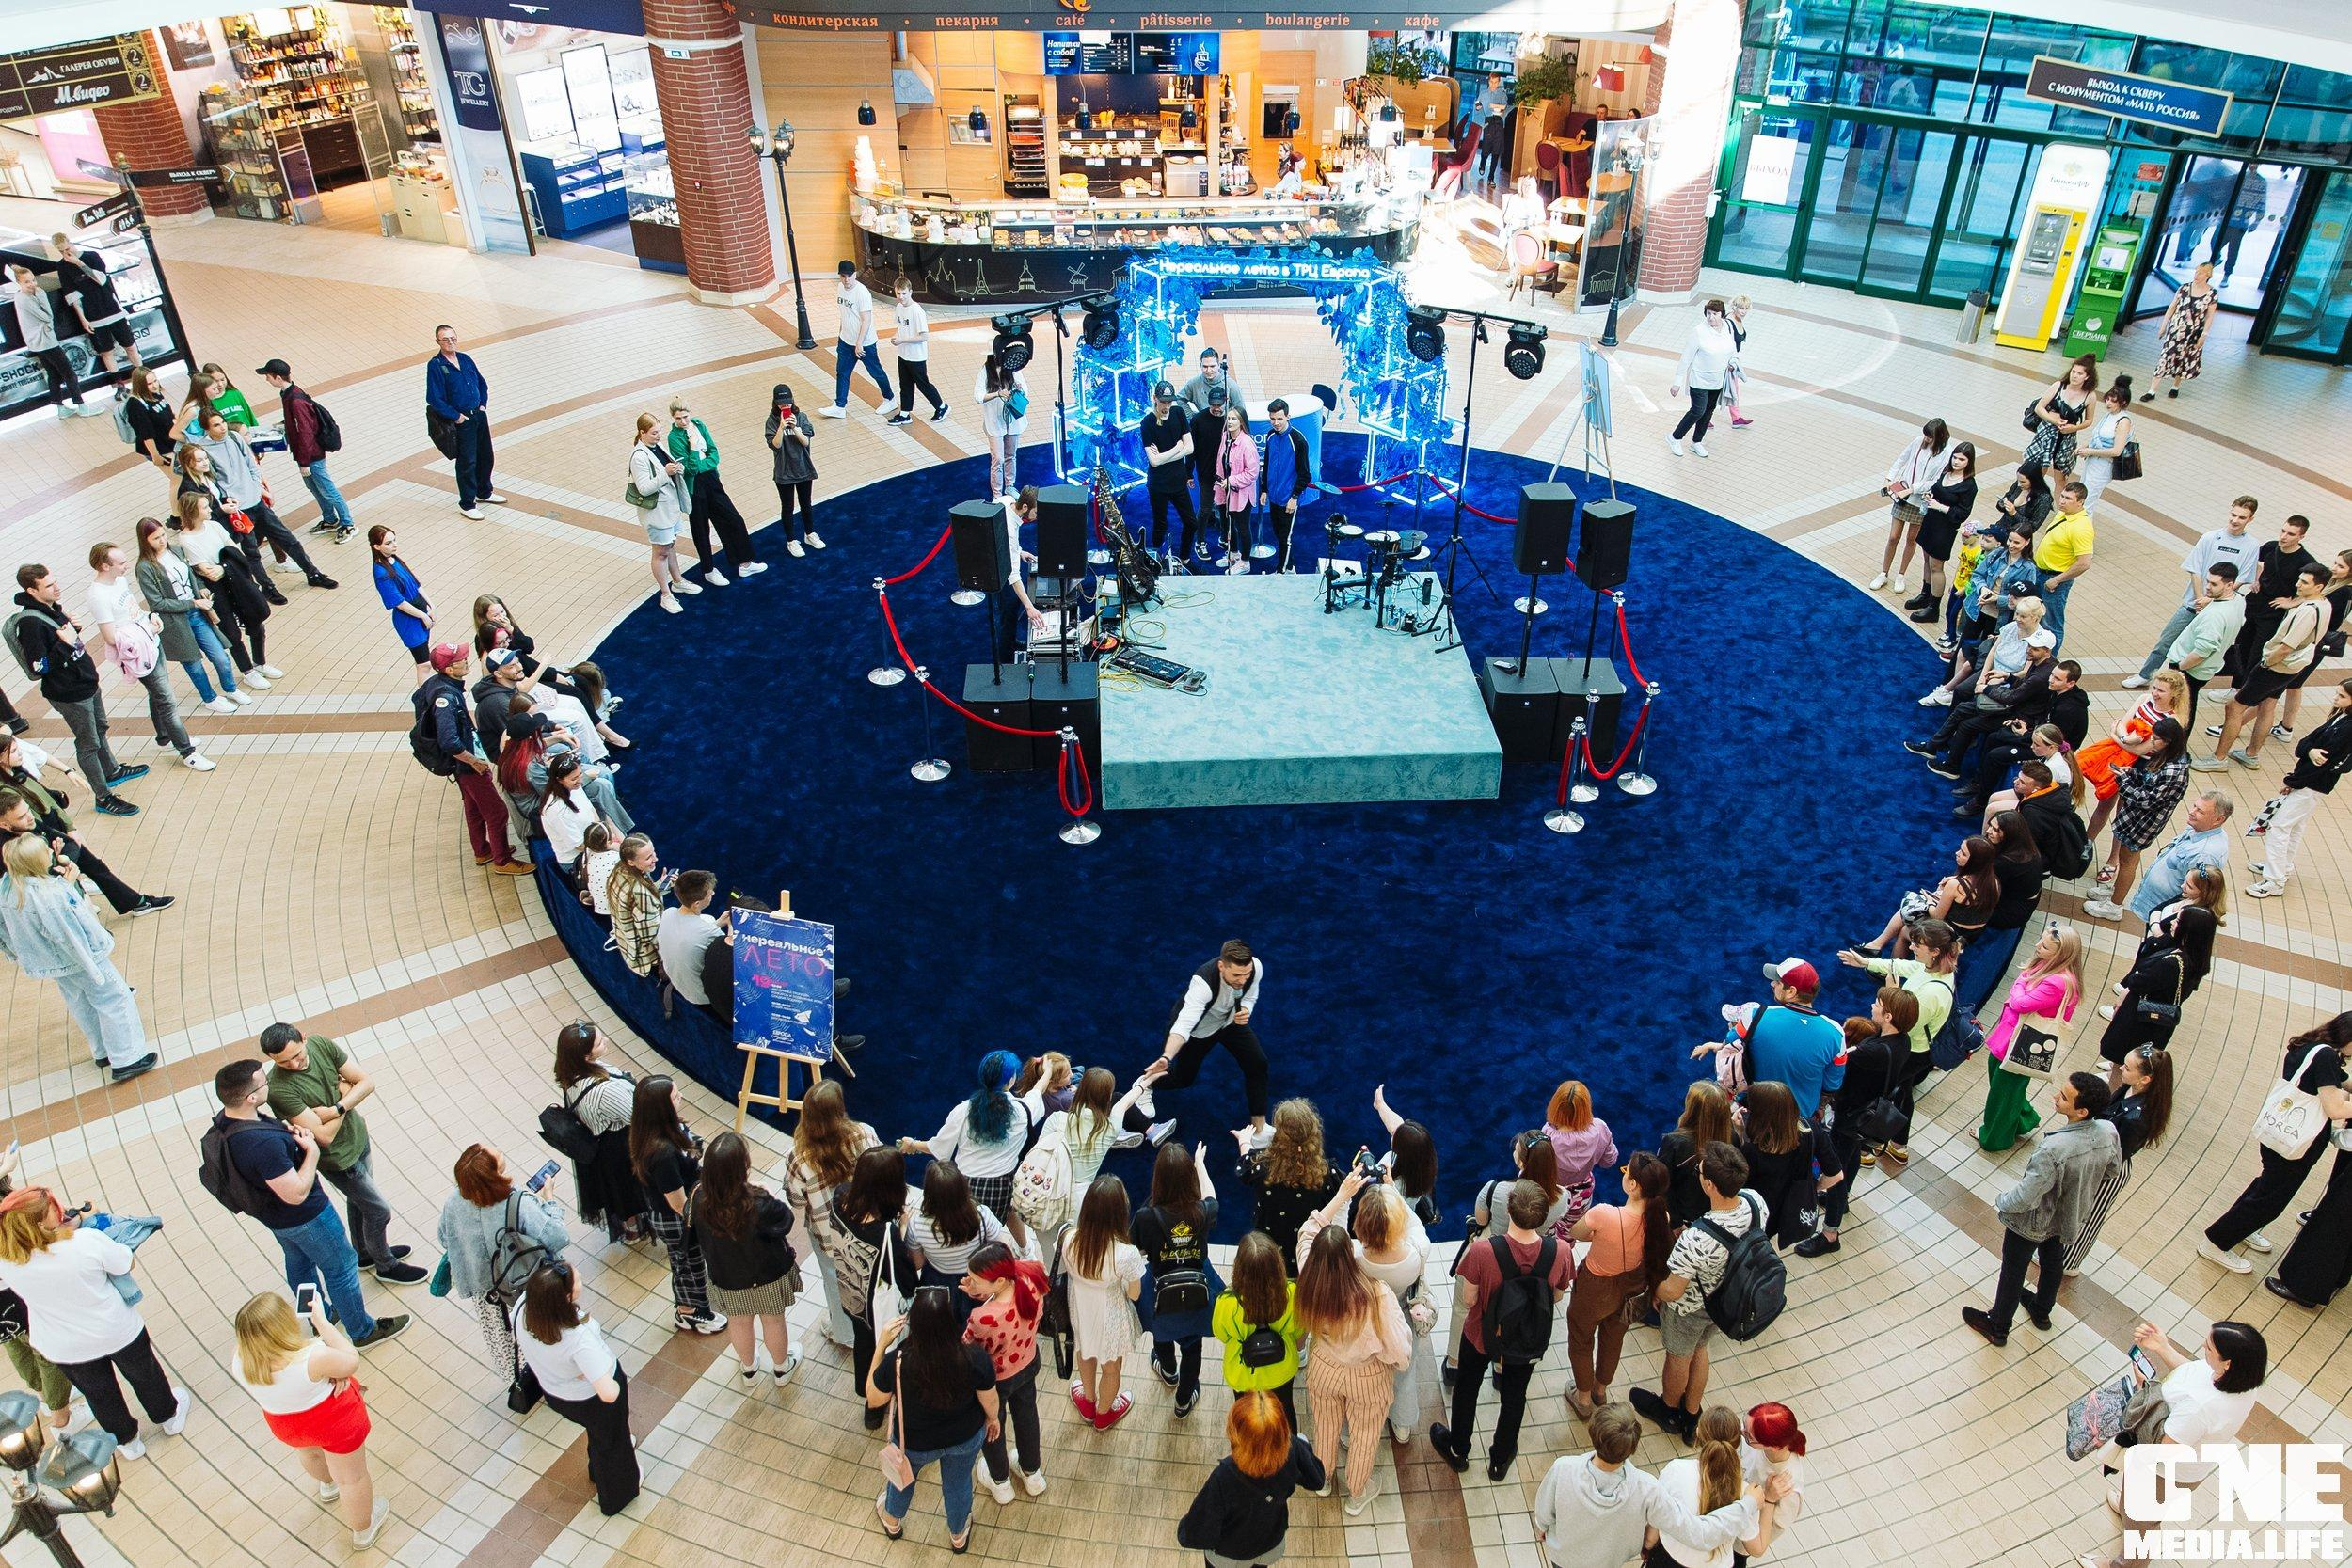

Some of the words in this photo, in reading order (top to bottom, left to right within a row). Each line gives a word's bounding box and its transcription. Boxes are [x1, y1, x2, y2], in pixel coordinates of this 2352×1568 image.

[773, 13, 879, 30] кондитерская
[934, 15, 999, 30] пекарня
[1056, 13, 1085, 26] café
[1140, 13, 1212, 29] pâtisserie
[1265, 13, 1350, 29] boulangerie
[1405, 14, 1439, 29] кафе
[59, 60, 92, 73] ГАЛЕРЕЯ
[93, 56, 120, 68] ОБУВИ
[130, 49, 138, 63] 2
[138, 74, 147, 87] 2
[453, 71, 486, 96] TG
[2087, 77, 2121, 93] ВЫХОД
[2122, 85, 2129, 93] К
[2130, 87, 2166, 101] СКВЕРУ
[54, 85, 110, 104] М.видео
[2048, 82, 2056, 91] С
[2056, 85, 2124, 105] МОНУМЕНТОМ
[2125, 100, 2155, 112] «МАТЬ
[2156, 104, 2201, 120] РОССИЯ»
[1750, 164, 1788, 176] ВЫХОД
[1159, 259, 1240, 275] Нереальное
[1243, 265, 1279, 276] лето
[1293, 263, 1318, 279] ТРЦ
[1321, 266, 1371, 278] Европа
[2073, 330, 2107, 342] СБЕРБАНК
[0, 362, 40, 381] -SHOCK
[741, 934, 824, 957] нереальное
[743, 944, 825, 977] ЛЕТО
[2264, 1111, 2299, 1139] KOREA
